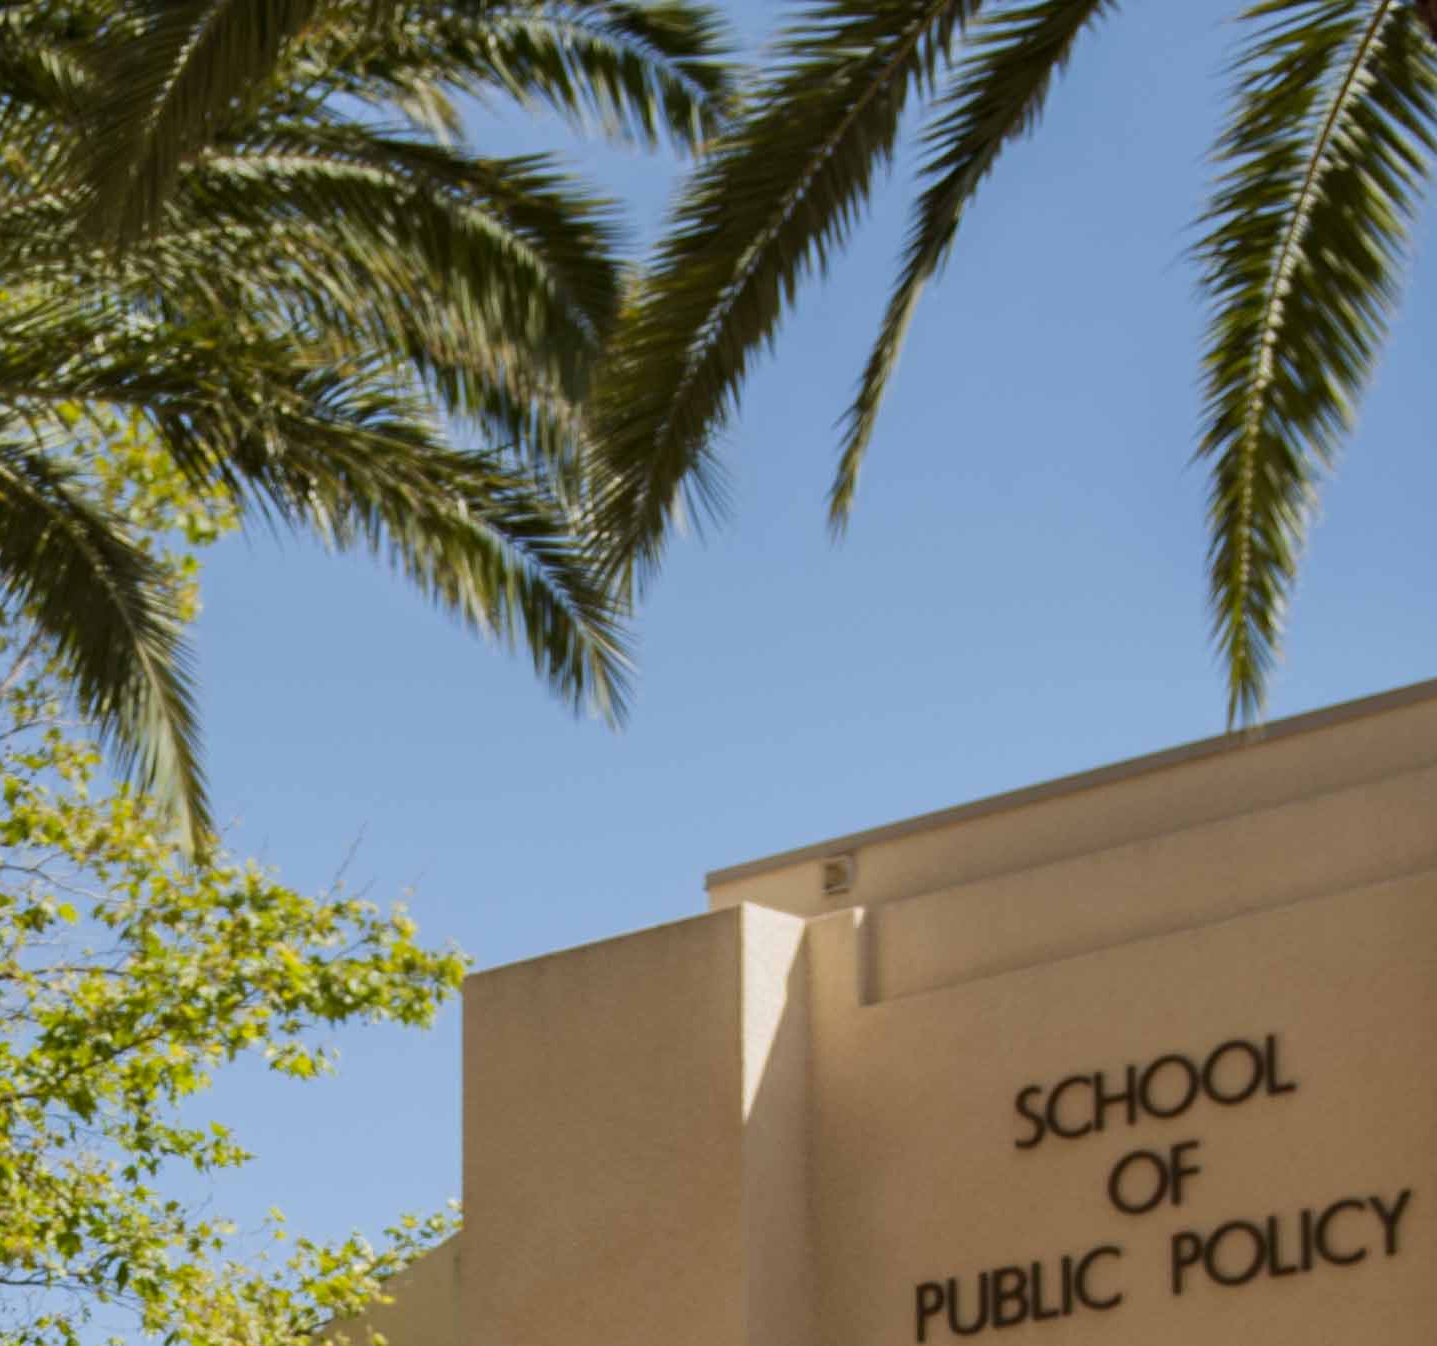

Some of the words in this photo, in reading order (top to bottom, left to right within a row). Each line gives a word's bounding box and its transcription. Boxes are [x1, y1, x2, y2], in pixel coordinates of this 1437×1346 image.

[1014, 1033, 1298, 1152] SCHOOL
[1107, 1139, 1201, 1217] OF
[915, 1245, 1123, 1345] PUBLIC
[1170, 1188, 1413, 1297] POLICY
